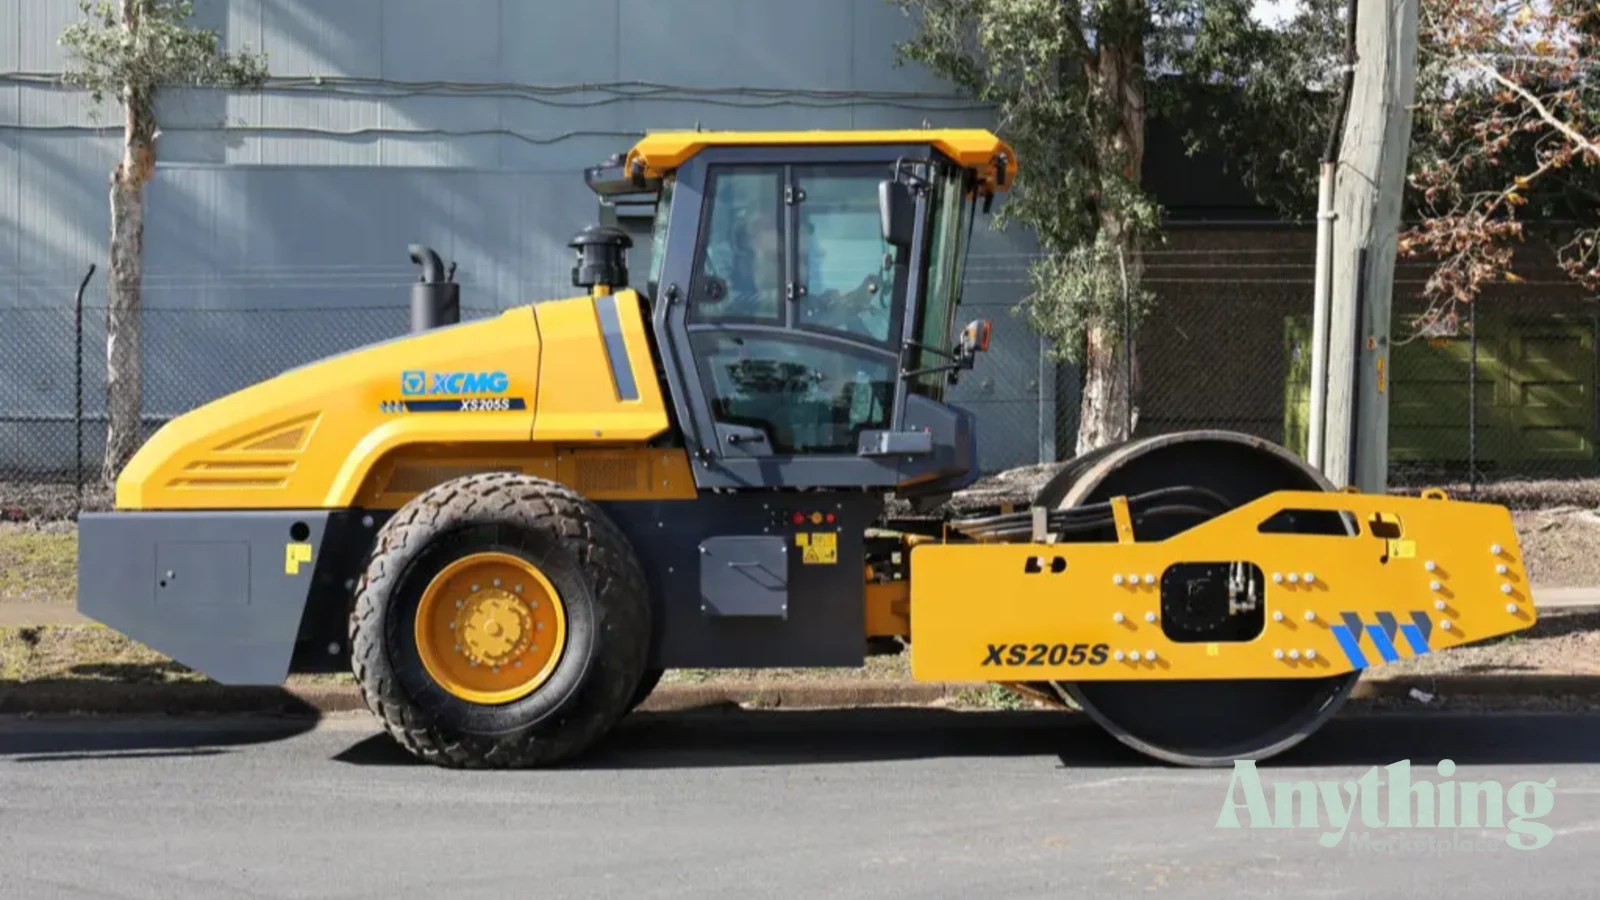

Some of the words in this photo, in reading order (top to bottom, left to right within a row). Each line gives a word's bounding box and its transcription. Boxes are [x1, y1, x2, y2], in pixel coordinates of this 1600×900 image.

[428, 372, 508, 394] XCMG
[460, 399, 509, 411] XS205S
[981, 643, 1109, 666] XS205S
